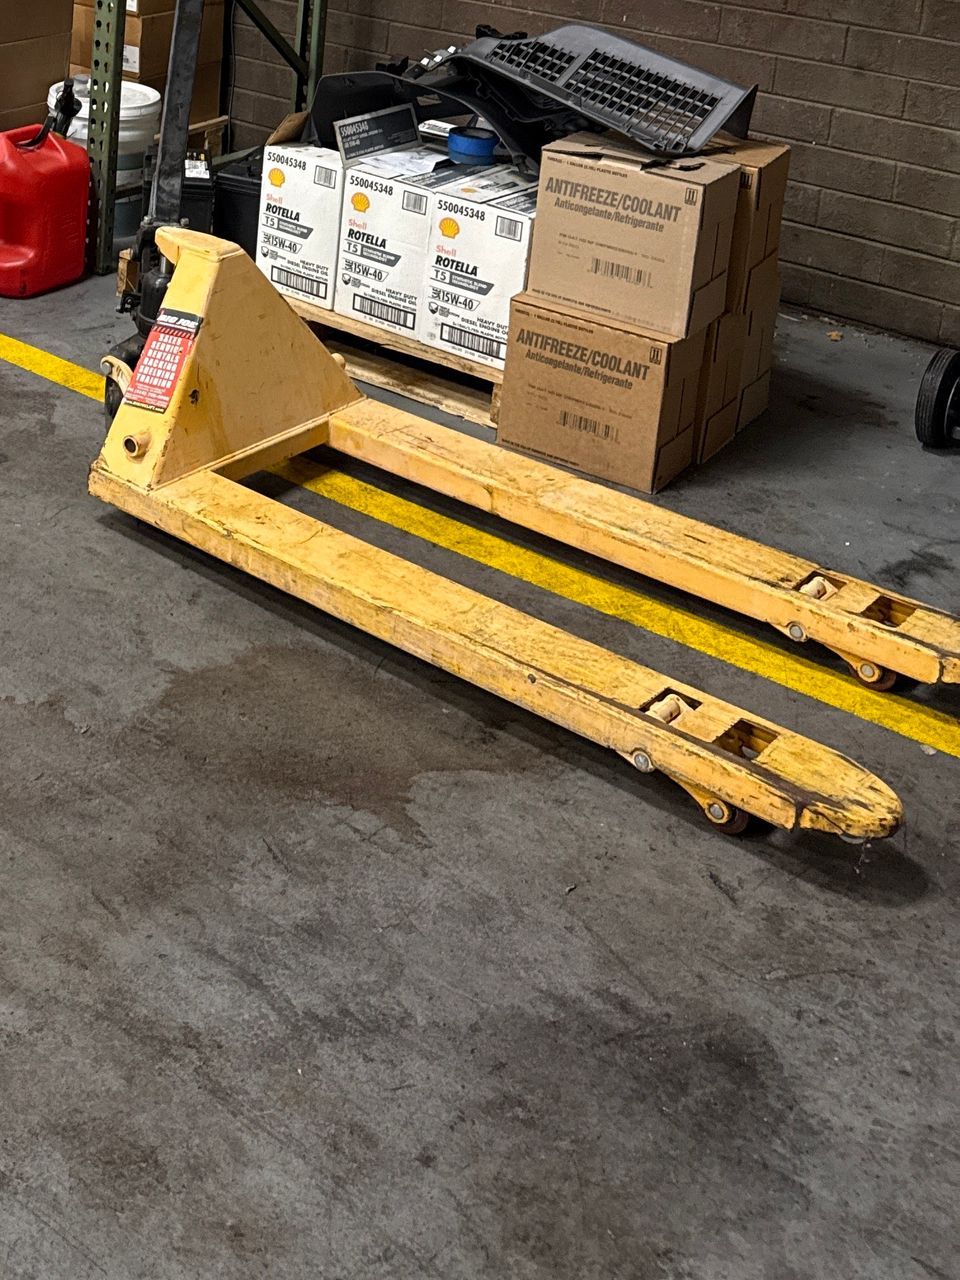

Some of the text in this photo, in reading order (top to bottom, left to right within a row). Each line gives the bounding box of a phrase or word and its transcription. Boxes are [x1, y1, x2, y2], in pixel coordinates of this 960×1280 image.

[267, 151, 307, 171] 550045348
[349, 175, 394, 196] 550045348
[266, 193, 284, 204] Shell
[545, 176, 682, 223] ANTIFREEZE/COOLANT
[266, 202, 300, 222] ROTELLA
[438, 199, 486, 222] 550045348
[554, 196, 665, 233] Anticongelante/Refrigerante
[264, 216, 275, 226] T5
[348, 218, 368, 230] Shell
[271, 235, 298, 253] 15W-40
[348, 228, 387, 249] ROTELLA
[346, 242, 358, 253] T5
[435, 244, 457, 257] Shell
[287, 260, 300, 268] DIESEL
[300, 260, 314, 268] HEAVY
[354, 262, 382, 280] 15W-40
[435, 255, 478, 277] ROTELLA
[434, 269, 447, 281] T5
[371, 288, 386, 297] DIESEL
[386, 288, 402, 296] HEAVY
[442, 291, 474, 310] 15W-40
[461, 318, 477, 326] DIESEL
[477, 317, 495, 326] HEAVY
[158, 334, 182, 345] SALES
[147, 350, 180, 363] RENTALS
[516, 328, 650, 380] ANTIFREEZE/COOLANT
[144, 357, 177, 371] RACKING
[525, 349, 633, 390] Anticongelante/Refrigerante
[139, 365, 175, 380] SHELVING
[136, 374, 172, 388] TRAINING
